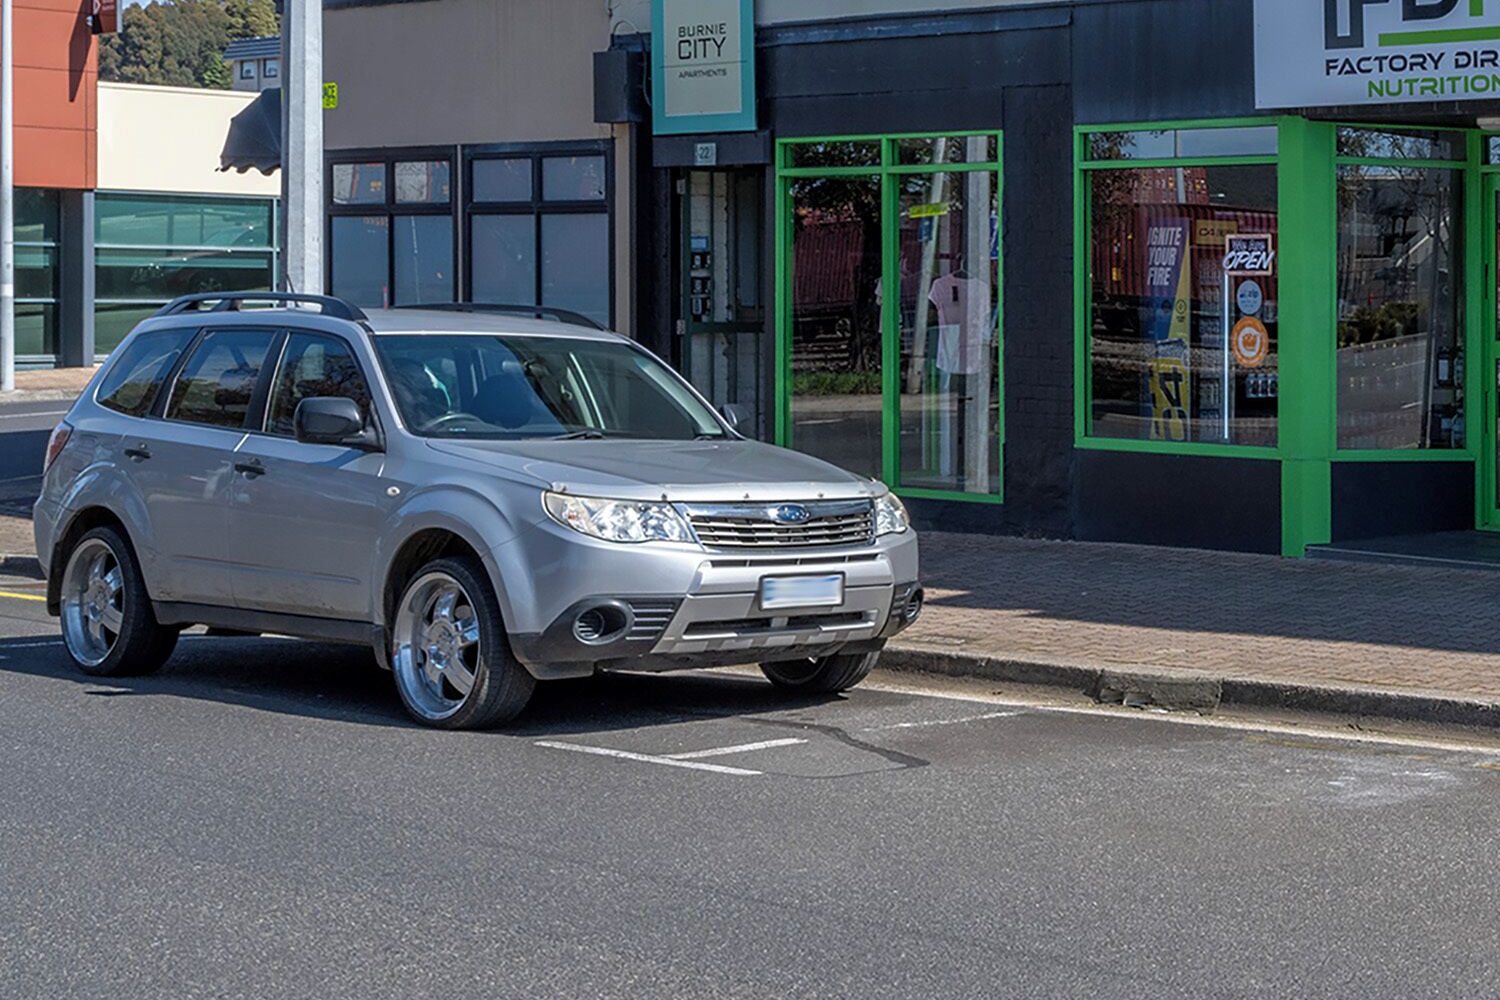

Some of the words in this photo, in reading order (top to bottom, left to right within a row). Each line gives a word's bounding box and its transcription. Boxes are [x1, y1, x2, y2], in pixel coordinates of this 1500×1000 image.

[678, 23, 726, 38] BURNIE
[678, 37, 726, 60] CITY
[1325, 51, 1446, 76] FACTORY
[1147, 227, 1182, 246] IGNITE
[1148, 246, 1178, 266] YOUR
[1222, 250, 1275, 270] OPEN
[1147, 266, 1172, 286] FIRE
